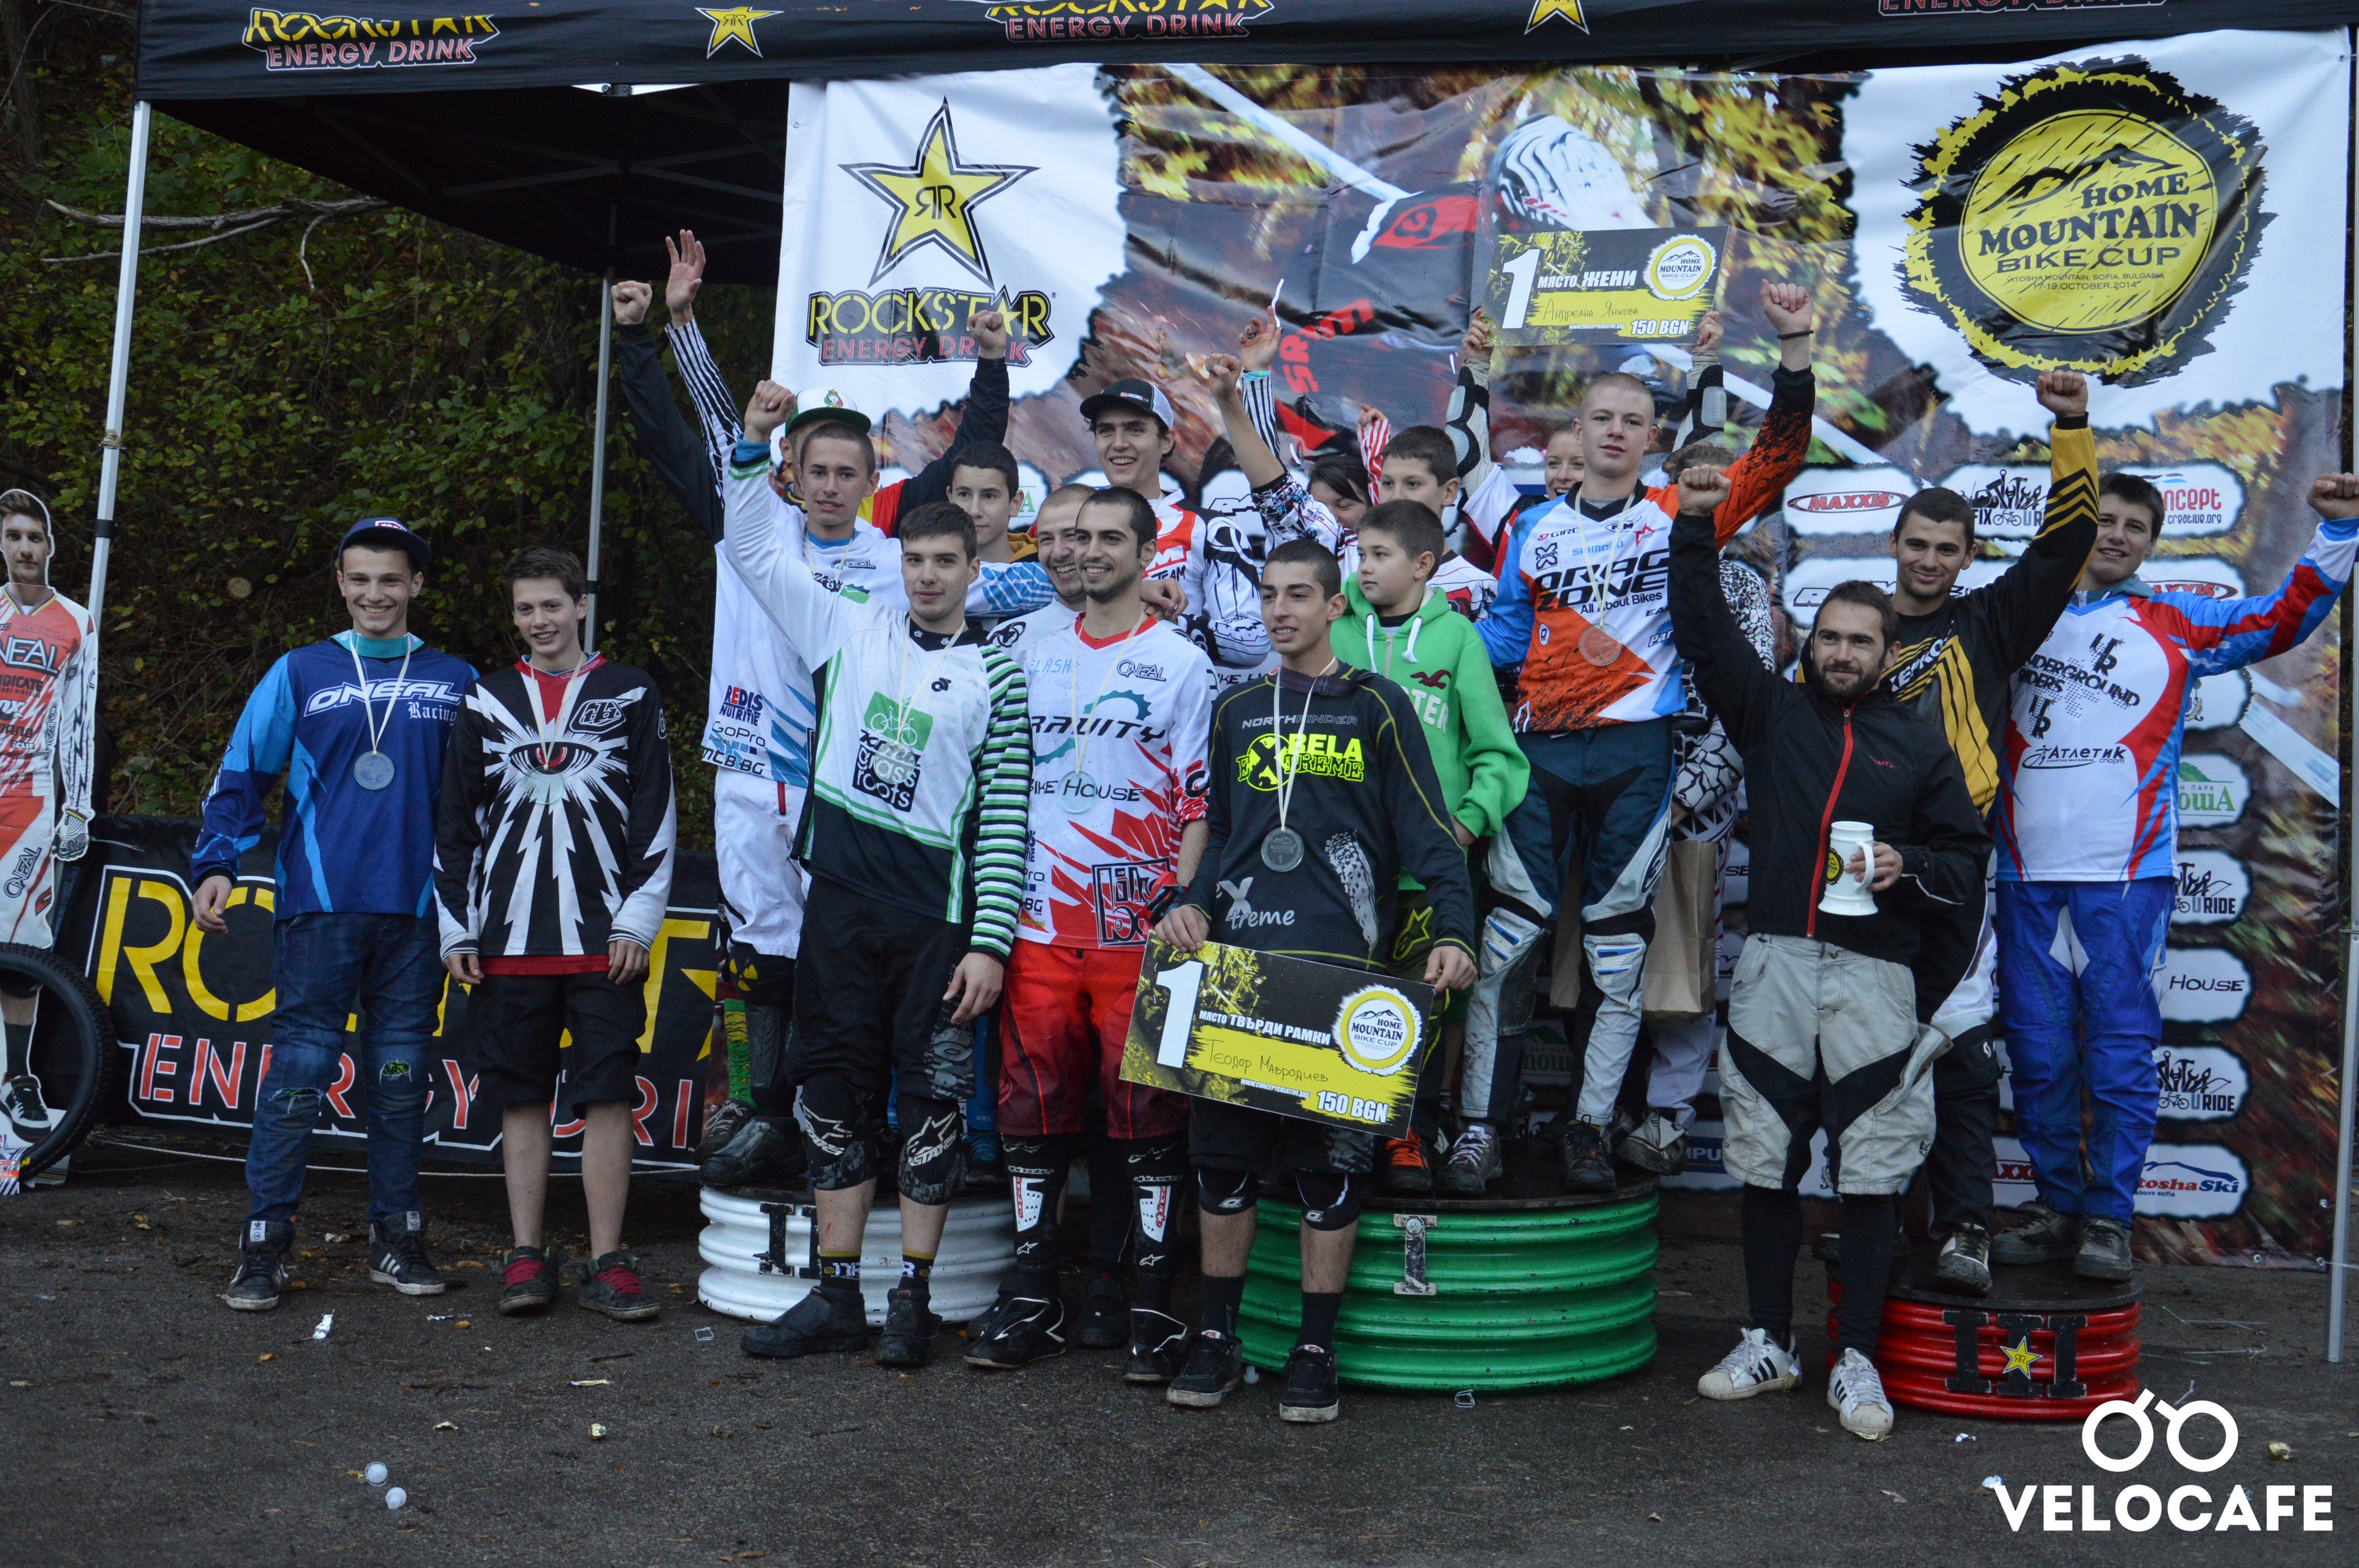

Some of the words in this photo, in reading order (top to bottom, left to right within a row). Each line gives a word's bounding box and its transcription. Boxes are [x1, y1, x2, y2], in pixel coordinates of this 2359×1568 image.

[1009, 15, 1131, 39] ENERGY
[1147, 12, 1245, 34] DRINK
[268, 42, 375, 67] ENERGY
[388, 38, 473, 62] DRINK
[2081, 171, 2190, 209] HOME
[1978, 202, 2200, 256] MOUNTAIN
[1659, 264, 1702, 273] MOUNTAIN
[1997, 248, 2088, 274] BIKE
[2095, 246, 2181, 267] CUP
[1502, 248, 1541, 329] 1
[1537, 275, 1577, 289] МЯСТО
[1581, 270, 1638, 287] ЖЕНИ
[1631, 319, 1658, 335] 150
[1658, 319, 1691, 336] BGN
[822, 337, 927, 360] ENERGY
[938, 336, 1028, 362] DRK
[1807, 492, 1891, 511] MAXXIS
[2164, 488, 2222, 511] ncept
[2167, 513, 2222, 524] creative.org
[1537, 569, 1669, 613] ZONE
[1580, 604, 1594, 615] All
[1597, 598, 1630, 612] About
[1631, 592, 1663, 605] Bikes
[2025, 654, 2140, 707] NDERGROUND
[724, 685, 763, 712] REDIS
[408, 701, 458, 727] Racing
[1242, 714, 1359, 730] NORTHFINDER
[1030, 714, 1166, 743] RAVITY
[1288, 733, 1364, 762] BELA
[856, 770, 911, 808] roots
[2203, 897, 2236, 915] RIDE
[1156, 959, 1204, 1069] 1
[1198, 1009, 1228, 1025] МЯСТО
[1229, 1013, 1284, 1036] ТВЪРДИ
[1284, 1024, 1332, 1045] РАМКИ
[1376, 1018, 1402, 1030] HOME
[1350, 1021, 1404, 1042] MOUNTAIN
[1354, 1033, 1376, 1044] BIKE
[1377, 1037, 1398, 1047] CUP
[1316, 1090, 1348, 1115] 150
[1350, 1097, 1390, 1124] BGN
[2202, 1093, 2236, 1112] RIDE
